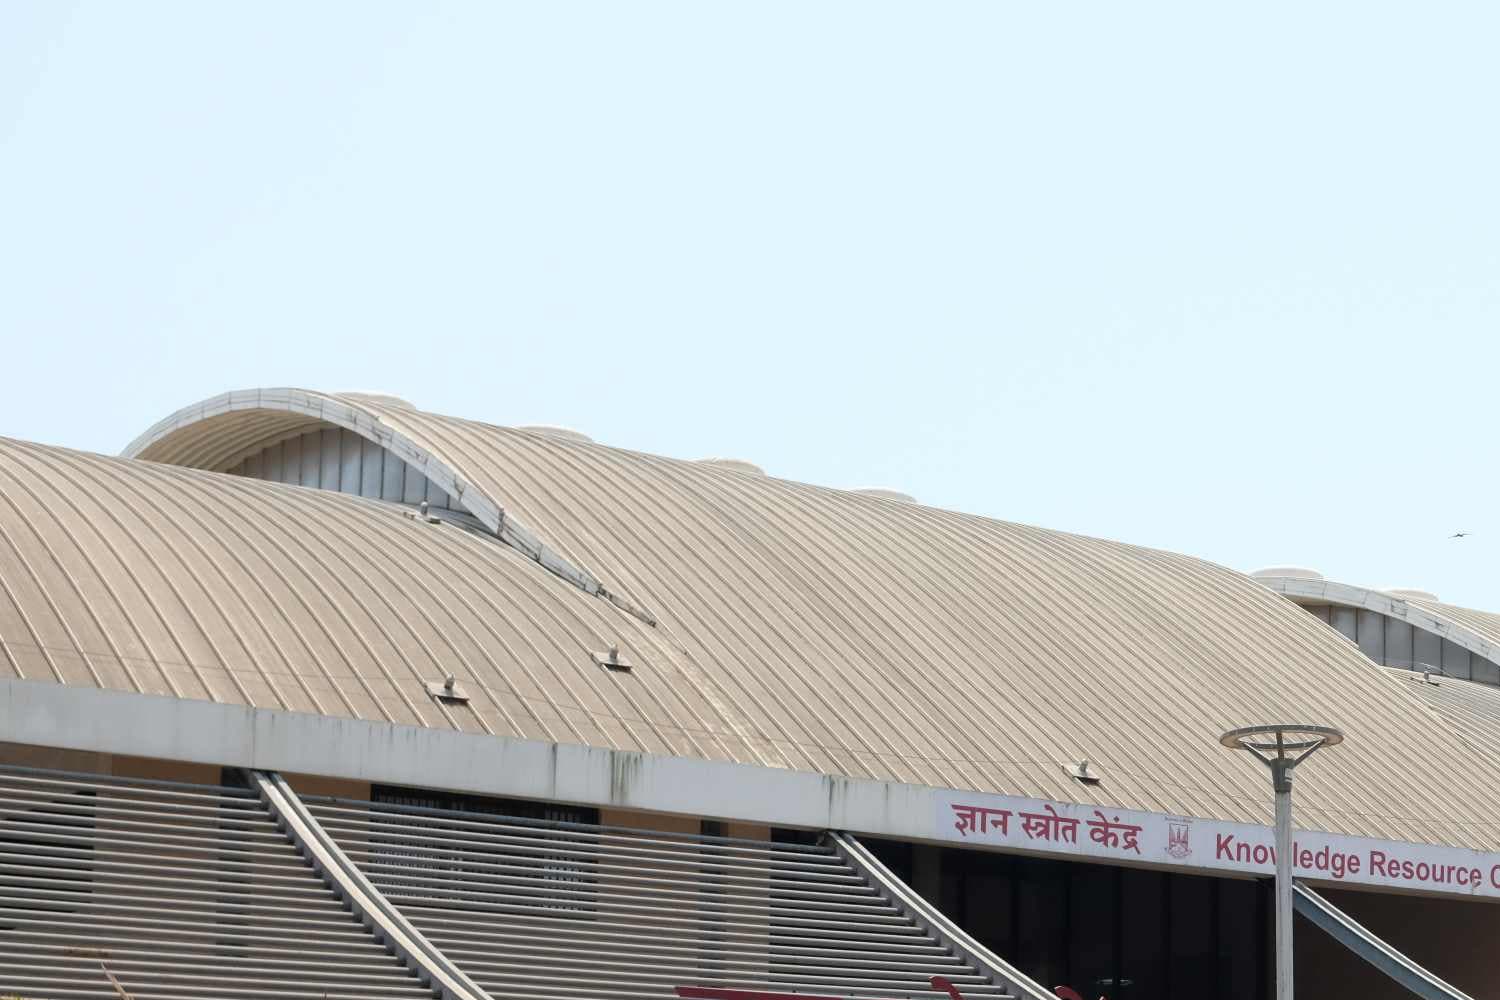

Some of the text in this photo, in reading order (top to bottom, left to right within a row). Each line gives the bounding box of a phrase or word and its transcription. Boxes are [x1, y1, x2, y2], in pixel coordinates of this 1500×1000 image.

[951, 804, 1013, 837] ज्ञान
[1086, 810, 1143, 854] केंद्र
[1369, 850, 1482, 887] Resource
